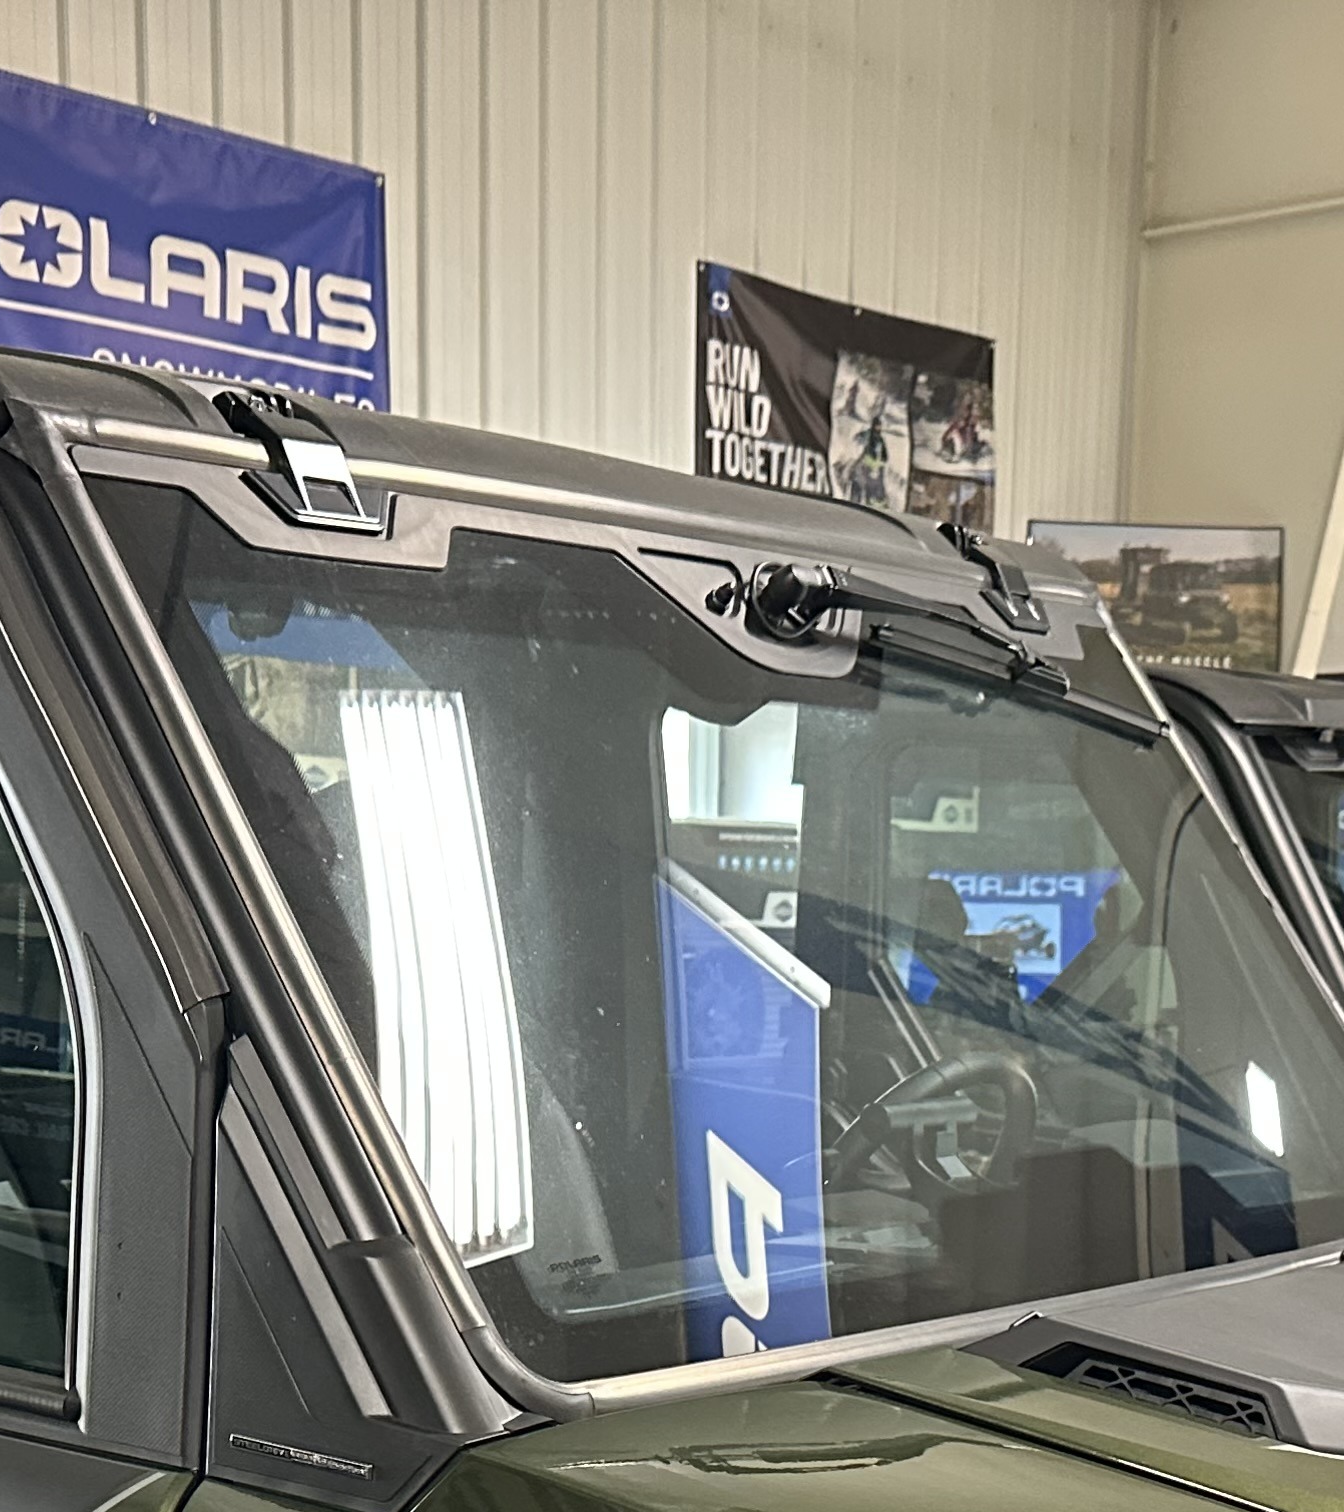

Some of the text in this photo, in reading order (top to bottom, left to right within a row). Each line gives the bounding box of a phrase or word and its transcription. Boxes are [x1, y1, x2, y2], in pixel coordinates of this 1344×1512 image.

[707, 339, 761, 393] RUN
[706, 384, 772, 438] WILD
[705, 430, 832, 496] TOGETHER
